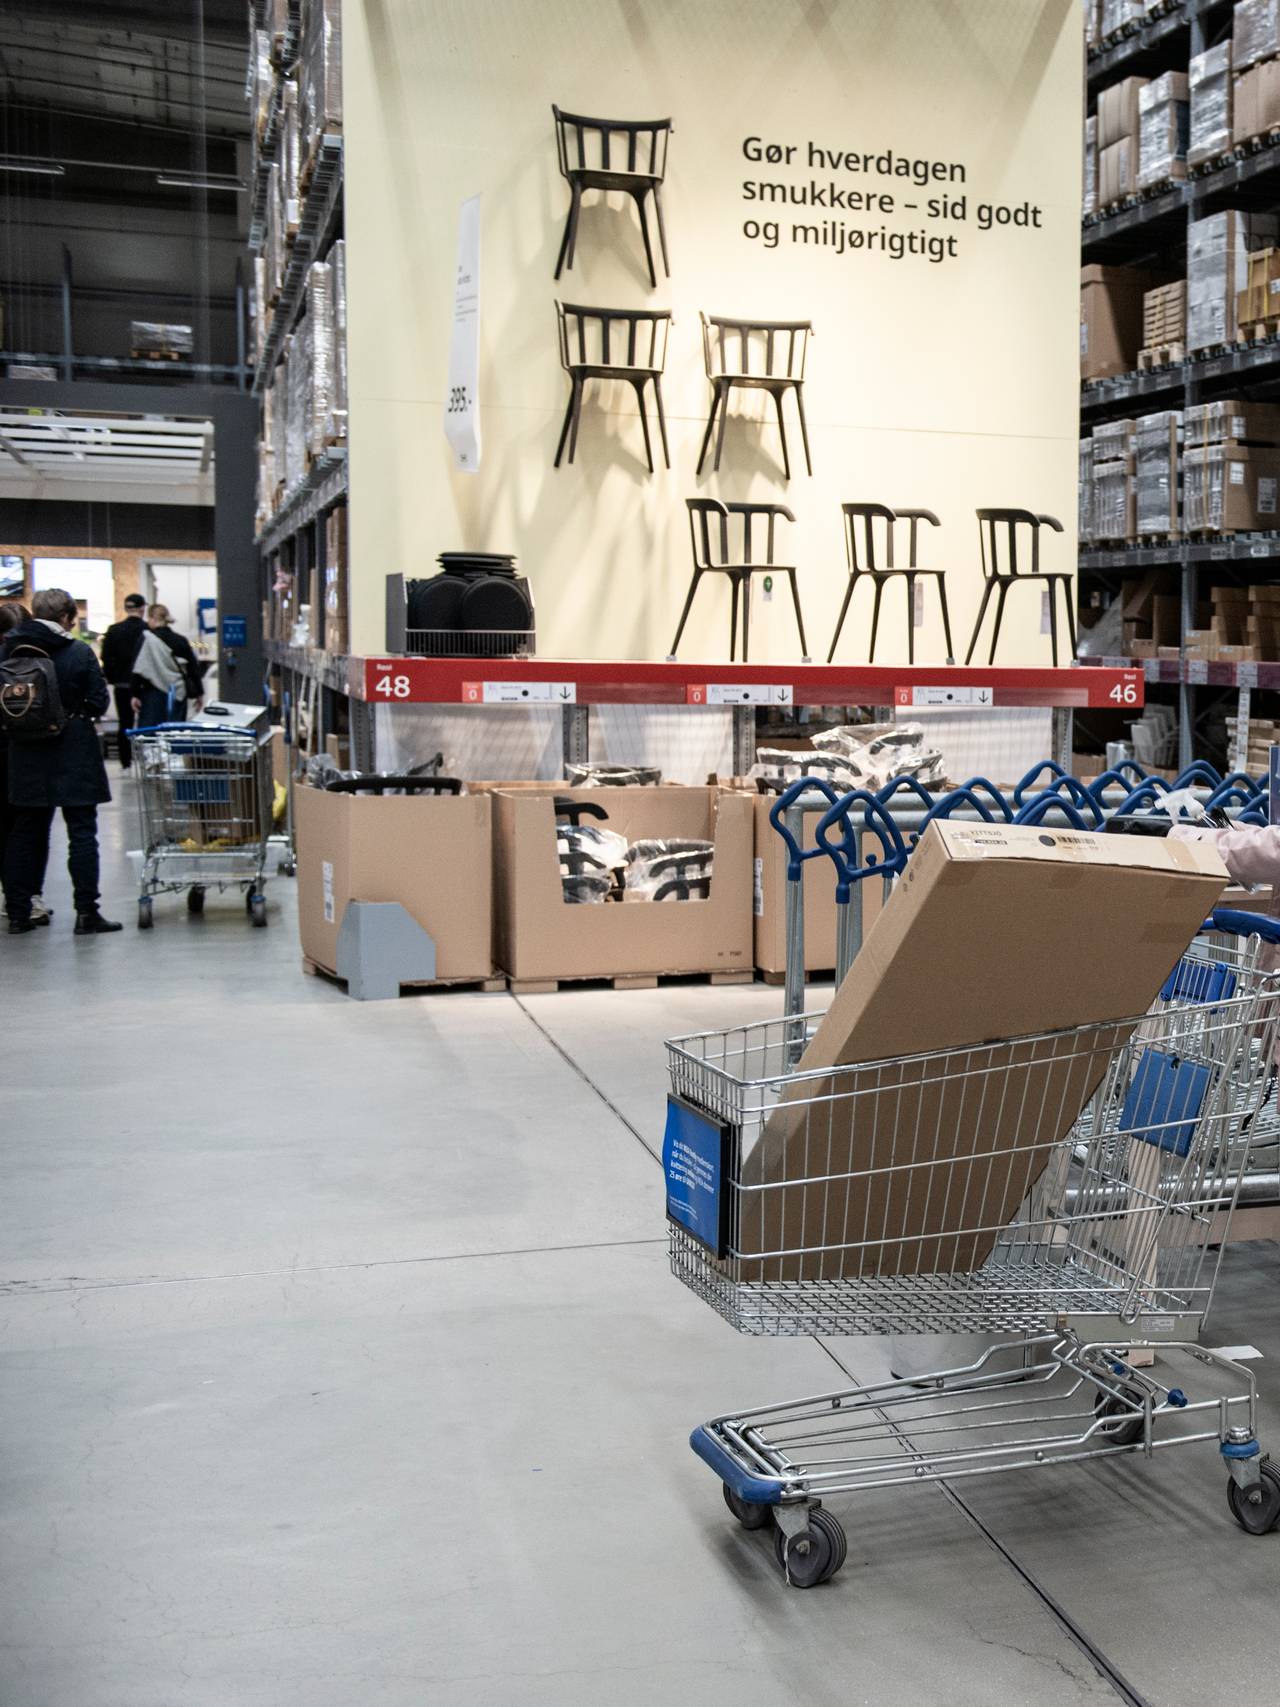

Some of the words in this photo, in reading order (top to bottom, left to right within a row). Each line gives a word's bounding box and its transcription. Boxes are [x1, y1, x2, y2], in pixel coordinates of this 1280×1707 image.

[742, 137, 797, 165] Gør
[808, 141, 966, 186] hverdagen
[742, 180, 894, 213] smukkere
[927, 195, 967, 221] sid
[977, 202, 1042, 230] godt
[743, 219, 779, 248] og
[792, 220, 957, 263] miljørigtigt
[375, 675, 411, 698] 48
[1109, 683, 1137, 704] 46
